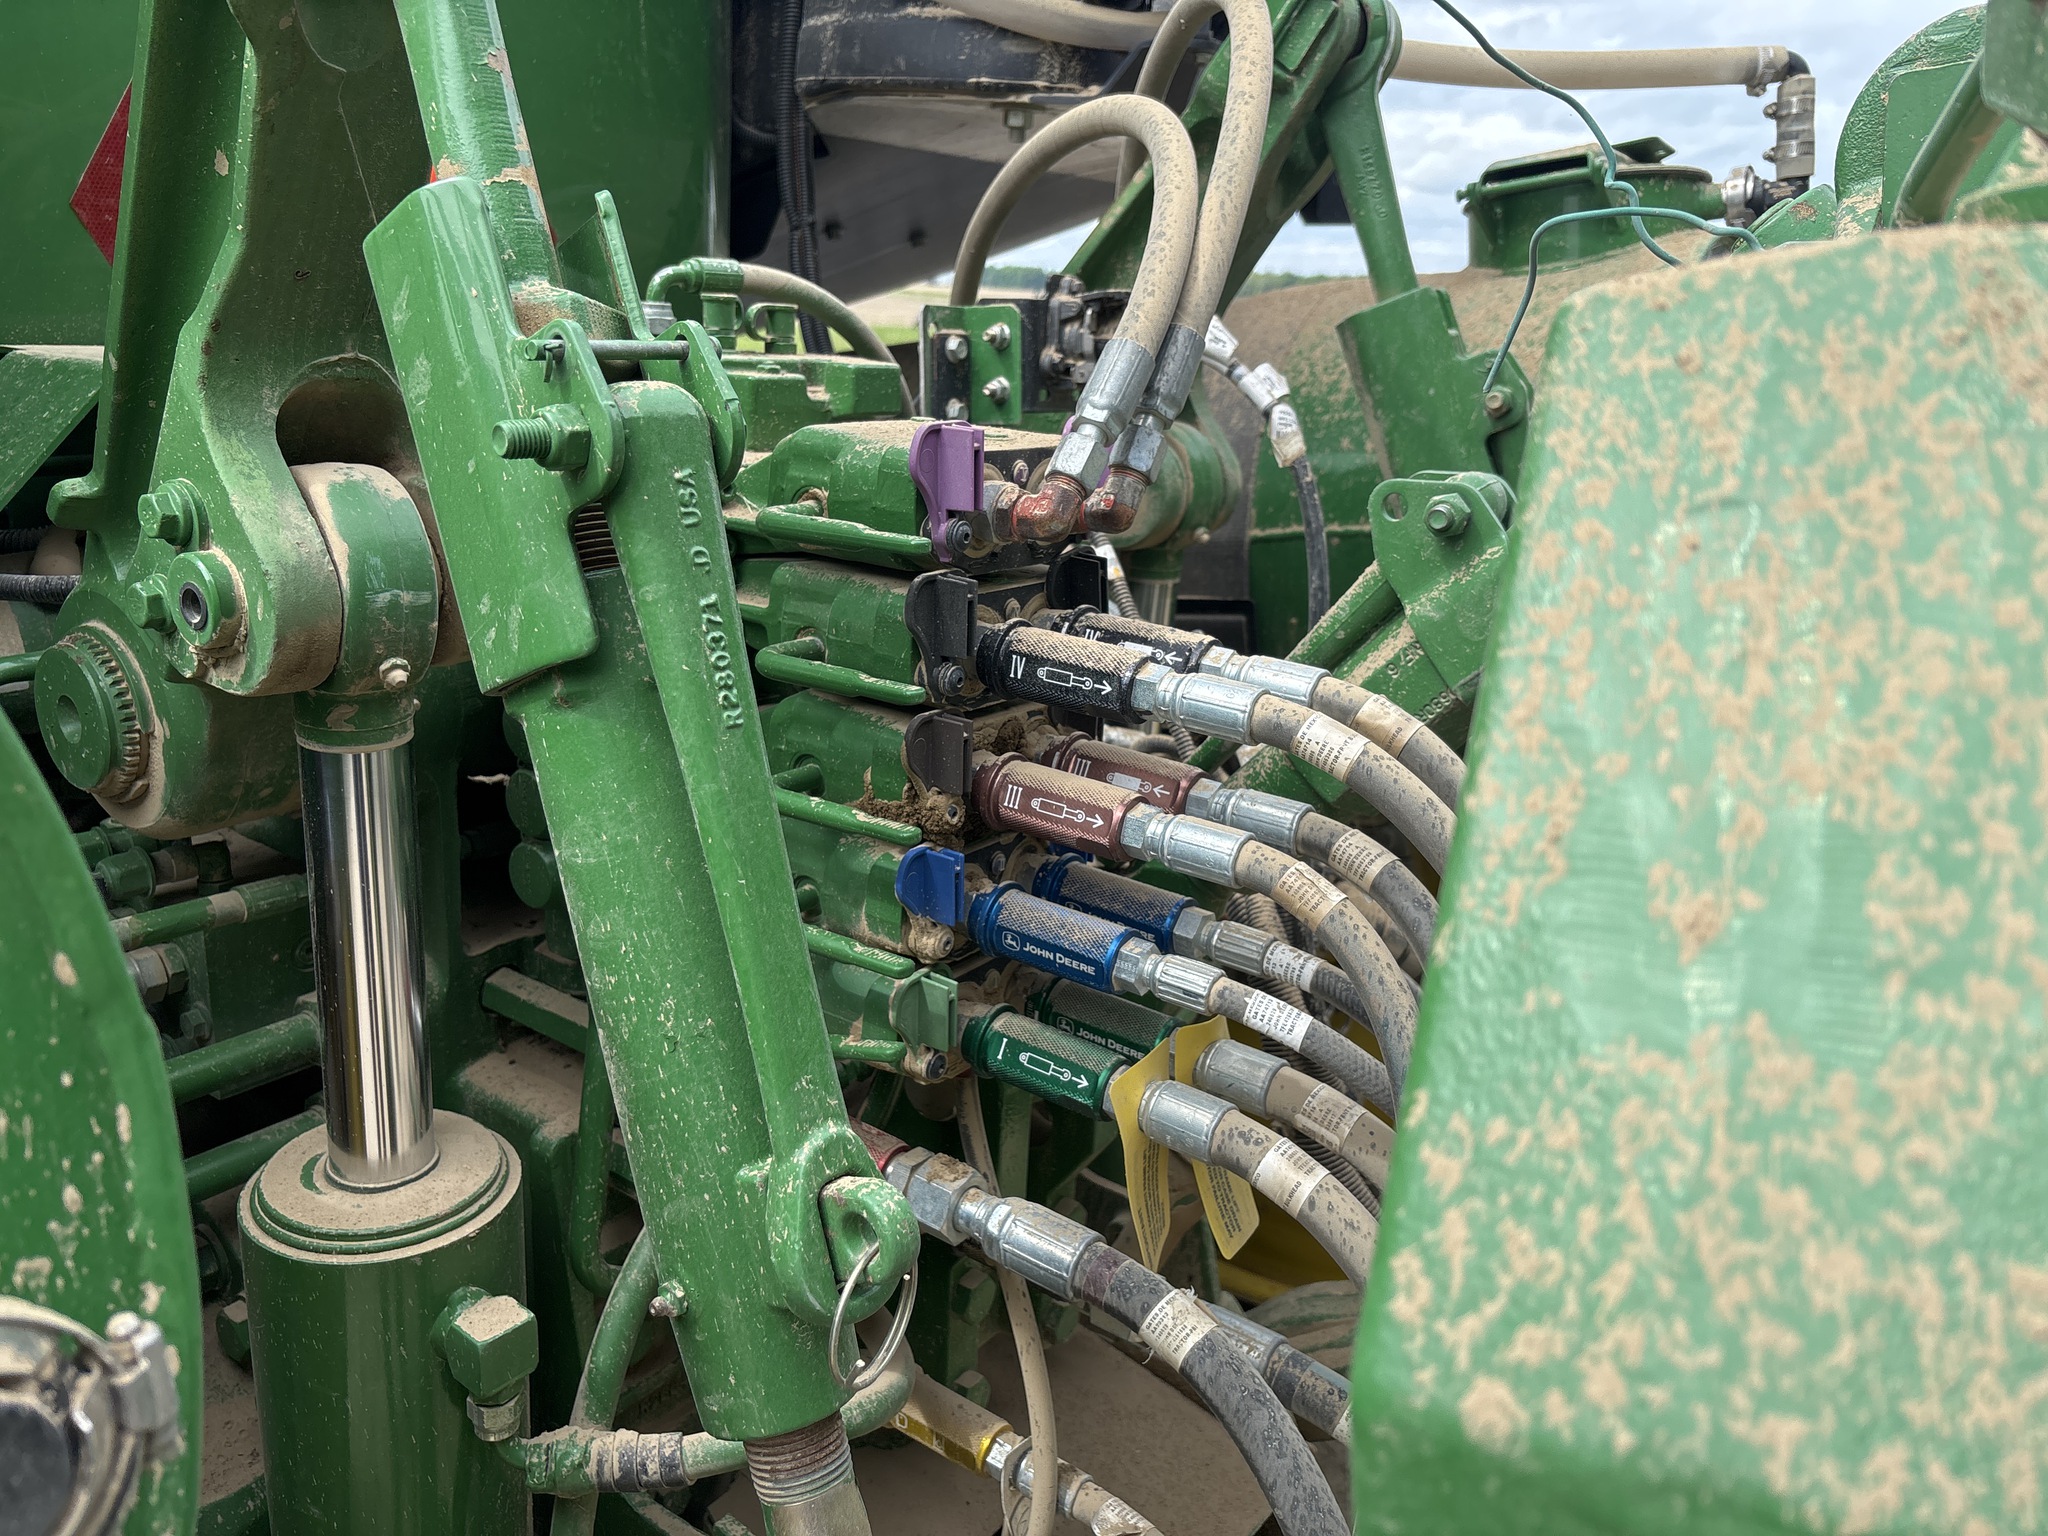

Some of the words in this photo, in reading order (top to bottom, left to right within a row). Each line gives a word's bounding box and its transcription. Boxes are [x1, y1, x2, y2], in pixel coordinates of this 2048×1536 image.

[673, 468, 702, 528] USA
[1010, 654, 1026, 680] IV
[1298, 730, 1308, 740] DE
[1074, 758, 1091, 777] III
[1004, 784, 1022, 809] III
[1023, 942, 1054, 961] JOHN
[1056, 953, 1095, 976] DEERE
[1250, 998, 1264, 1020] GATES
[997, 1037, 1008, 1060] I
[1076, 1028, 1105, 1045] JOHN
[1107, 1038, 1145, 1060] DEERE
[1144, 1311, 1160, 1330] GATES
[1157, 1303, 1166, 1313] DE
